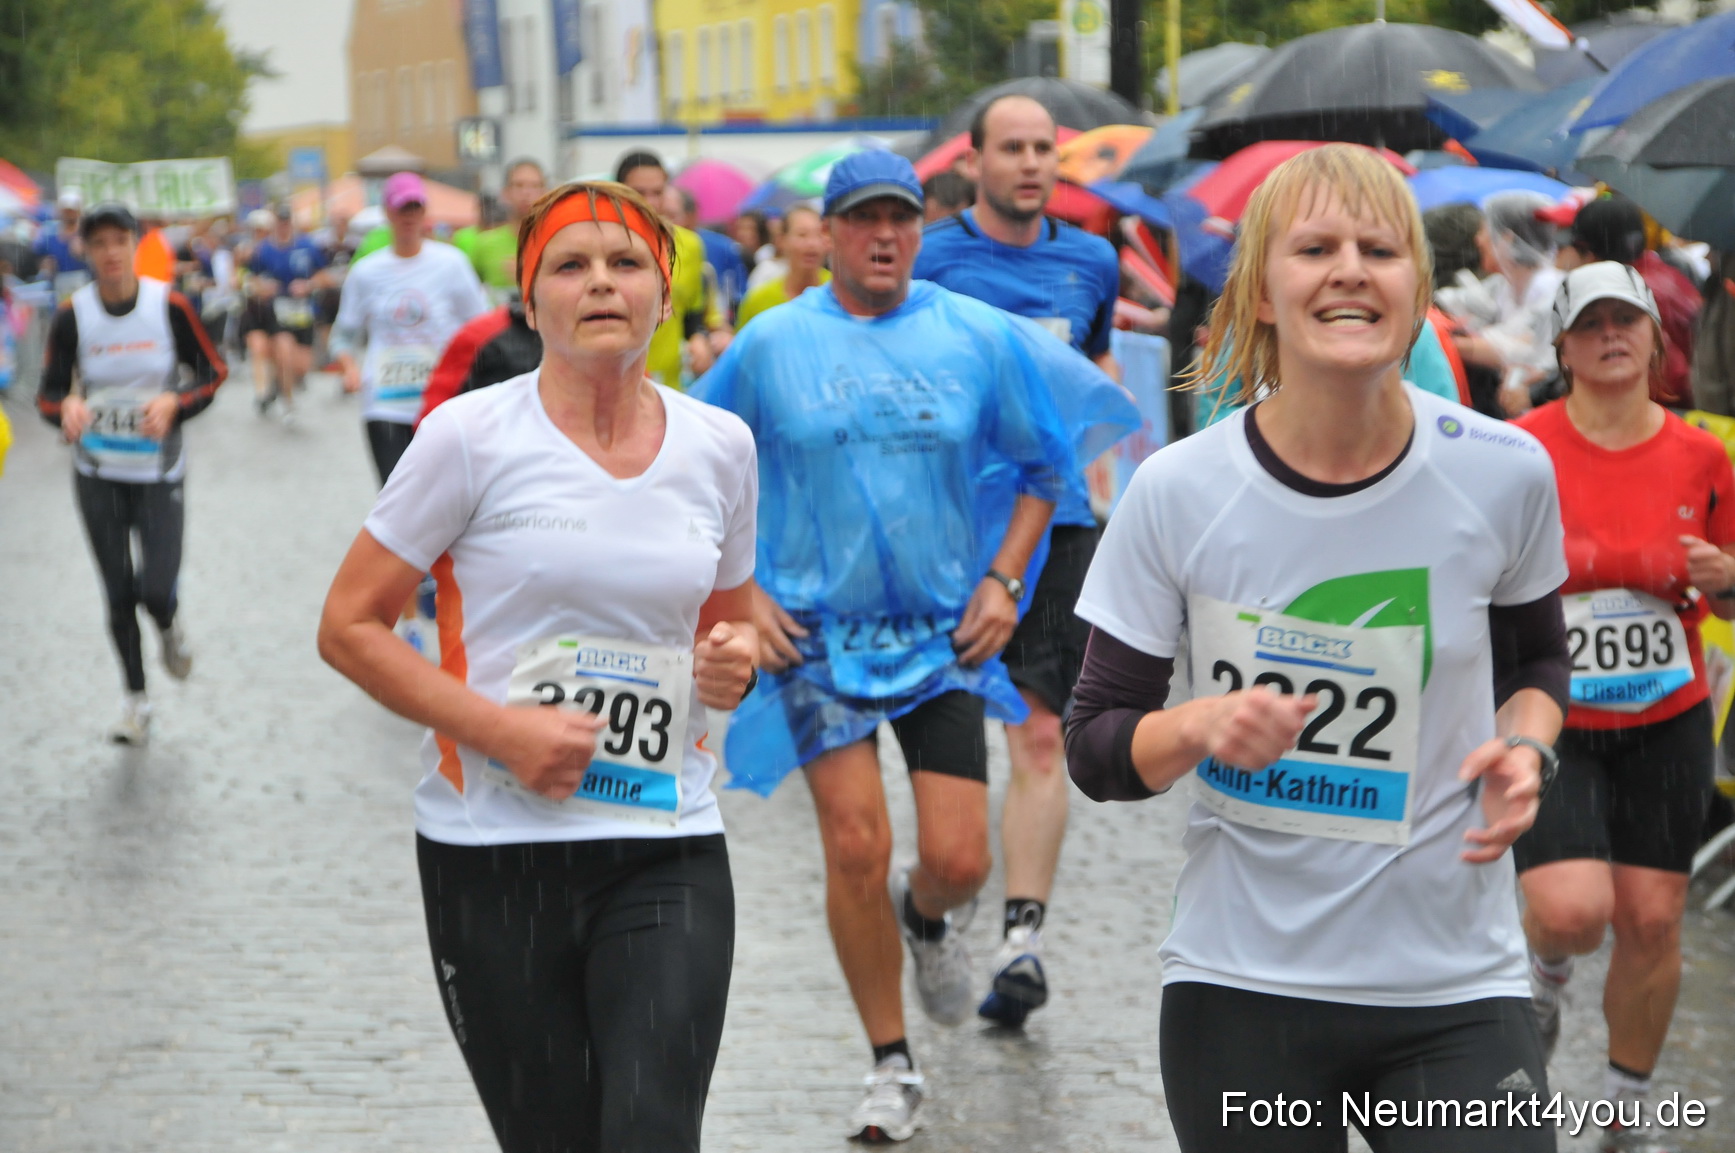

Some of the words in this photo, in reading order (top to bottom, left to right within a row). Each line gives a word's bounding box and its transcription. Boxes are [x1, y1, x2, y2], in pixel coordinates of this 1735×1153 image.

[89, 406, 146, 433] 244
[1256, 625, 1354, 659] BOCK
[1568, 619, 1675, 672] 2693
[577, 648, 648, 674] BOCK
[1581, 679, 1667, 701] Elisabeth
[1206, 755, 1379, 811] Ann-Kathrin
